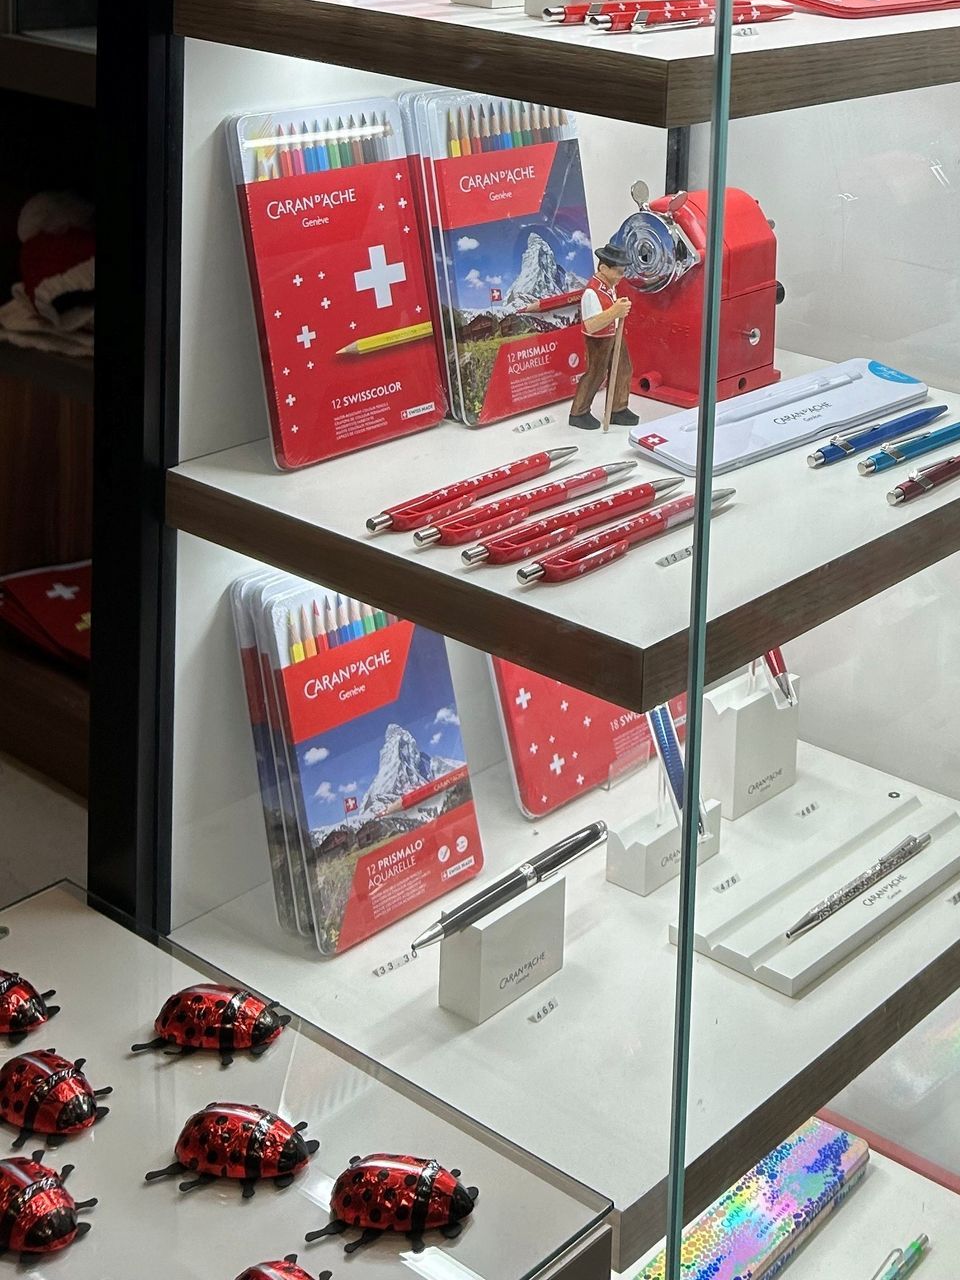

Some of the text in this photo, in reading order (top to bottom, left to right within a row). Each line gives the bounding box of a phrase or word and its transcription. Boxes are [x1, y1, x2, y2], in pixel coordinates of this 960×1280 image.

[302, 215, 330, 228] Genève
[507, 353, 516, 363] 12
[331, 381, 402, 410] 12 SWISSCOLOR
[339, 683, 366, 701] Genève
[610, 719, 620, 732] 18
[366, 863, 377, 877] 12
[536, 1000, 555, 1020] 465
